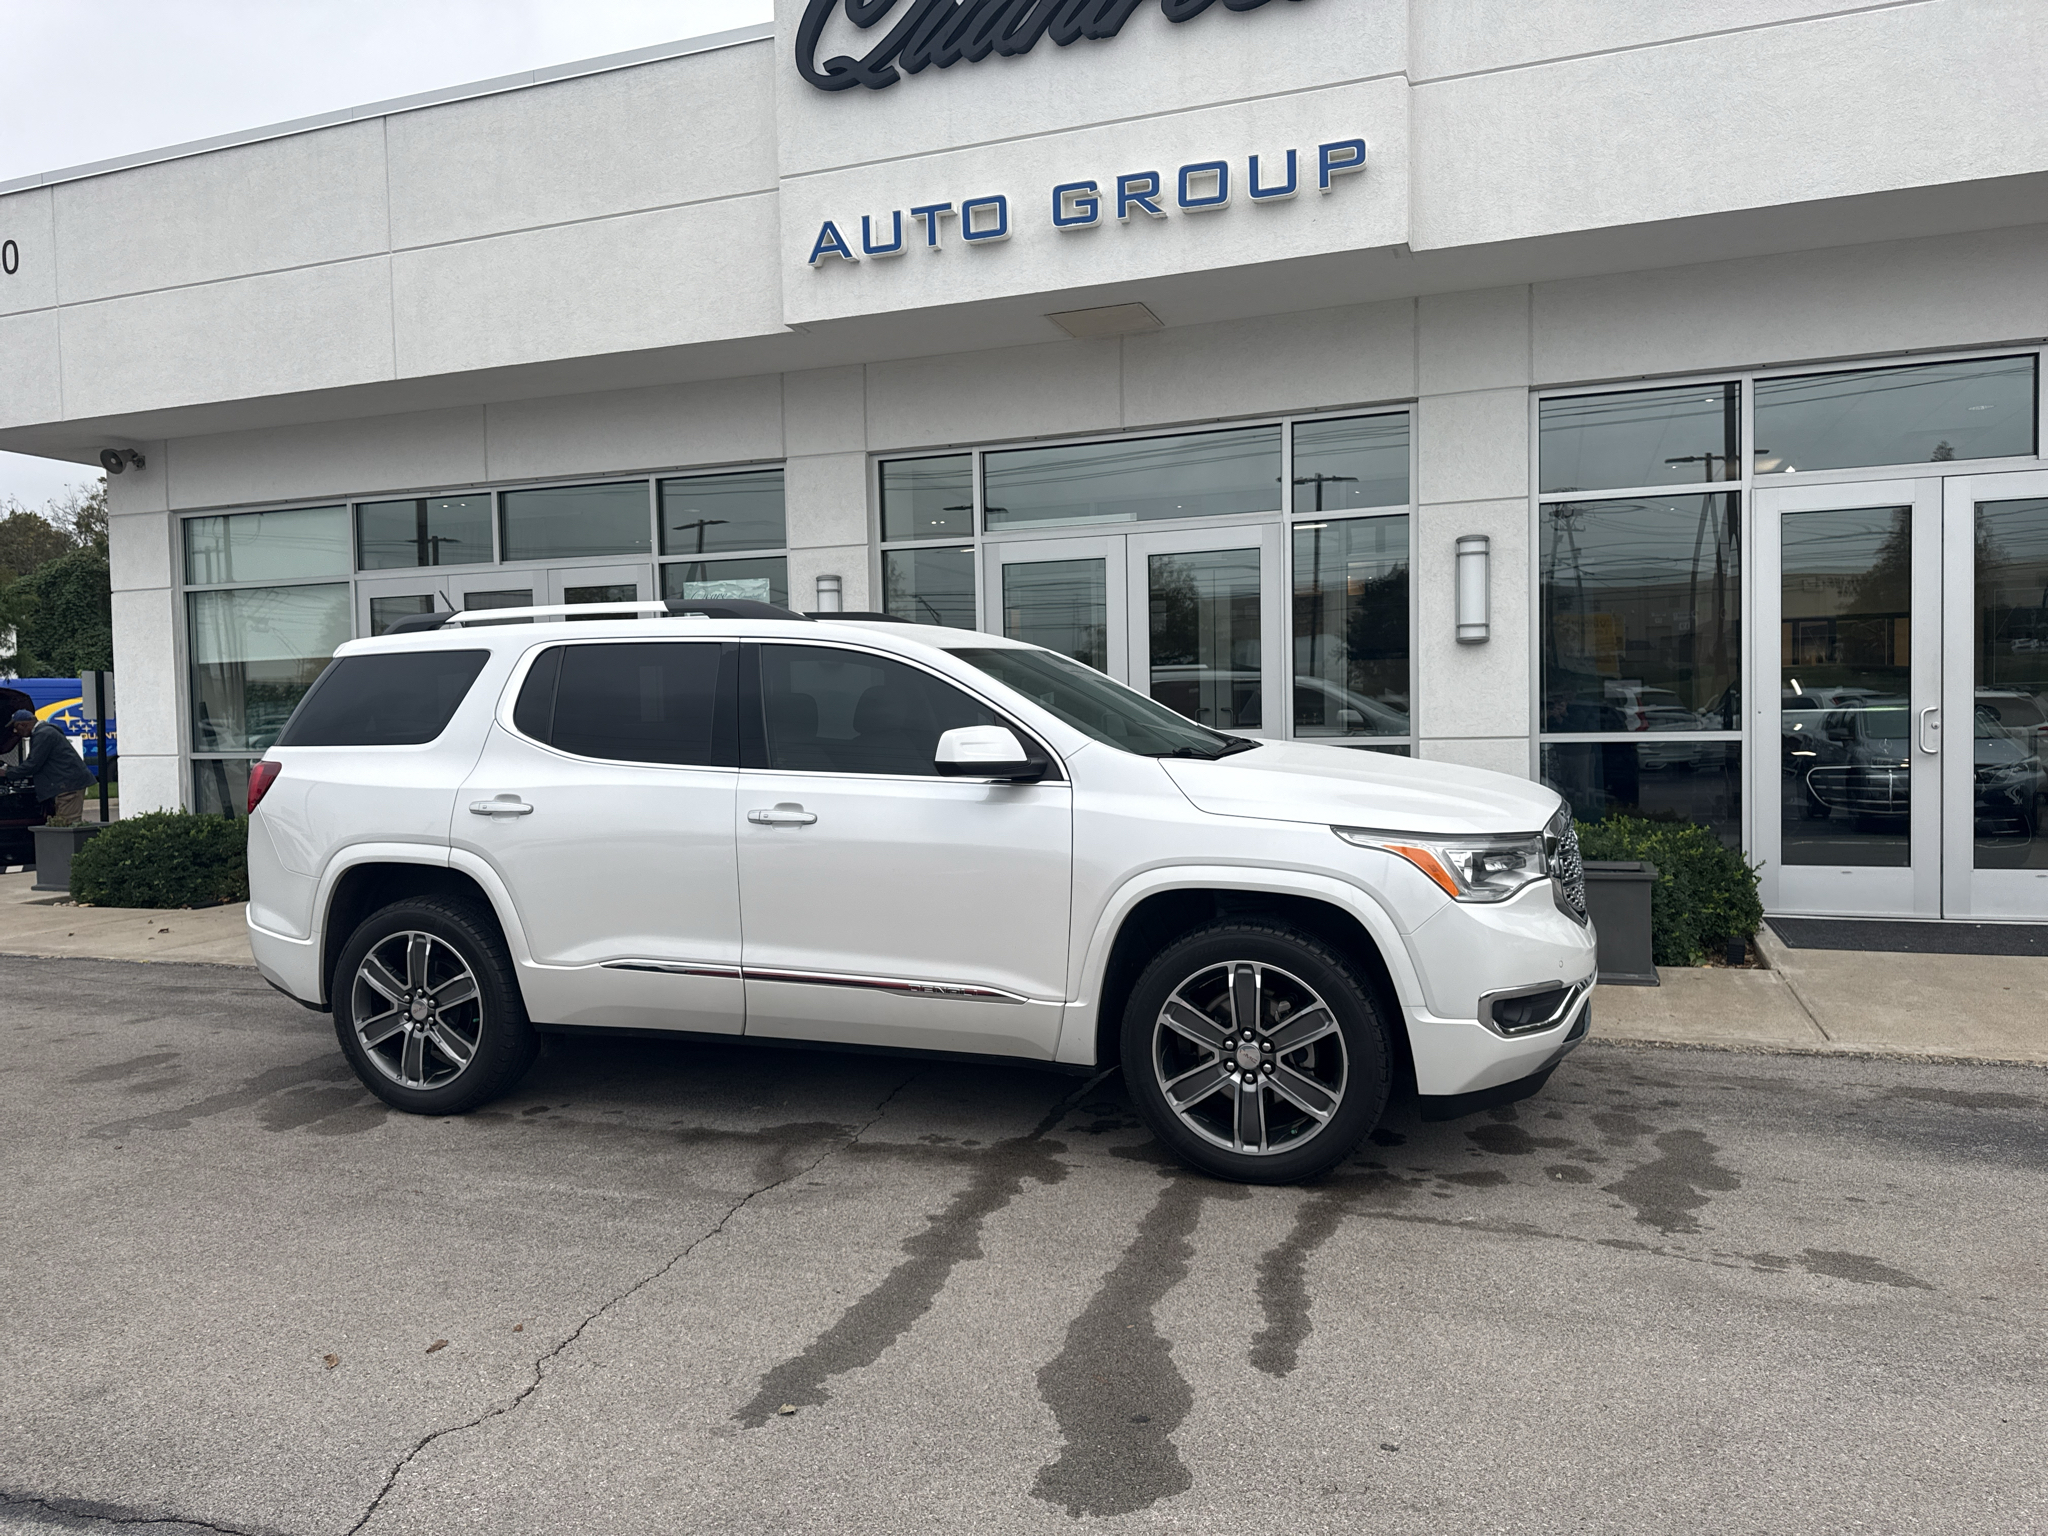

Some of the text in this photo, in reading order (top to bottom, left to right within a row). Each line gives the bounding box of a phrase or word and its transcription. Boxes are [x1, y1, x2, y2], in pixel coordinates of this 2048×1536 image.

[808, 138, 1368, 267] AUTO GROUP
[2, 240, 19, 275] 0
[80, 731, 117, 740] QUNT
[908, 984, 978, 997] DENALI
